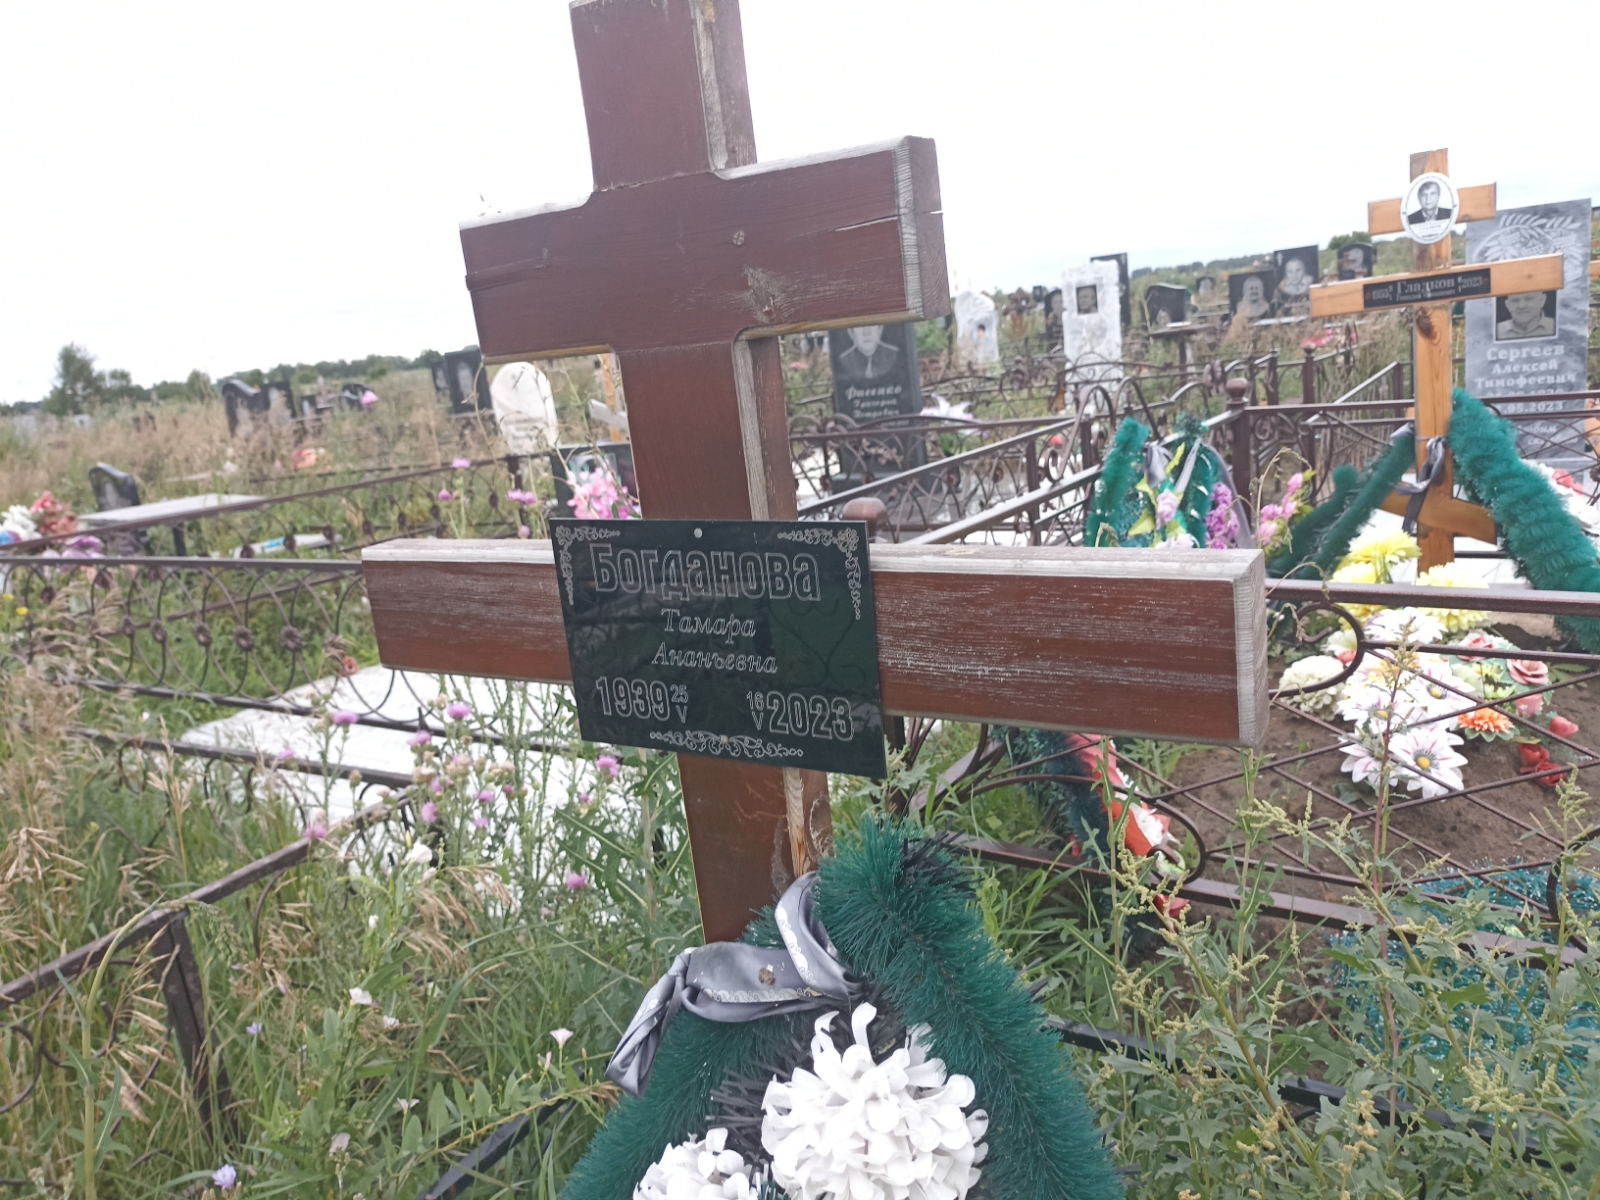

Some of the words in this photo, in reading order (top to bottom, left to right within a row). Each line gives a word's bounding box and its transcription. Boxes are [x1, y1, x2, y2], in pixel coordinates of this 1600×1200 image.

[1397, 278, 1455, 294] Гладков
[1462, 276, 1483, 289] 2023
[1486, 345, 1565, 362] Сергеев
[1491, 359, 1558, 374] Алексей
[1475, 373, 1577, 388] Тимофеевич
[589, 543, 821, 601] Богданова
[661, 608, 756, 643] Тамара
[651, 642, 778, 674] Ананьевна
[596, 676, 671, 721] 1939
[670, 683, 689, 703] 25
[766, 690, 855, 741] 2023
